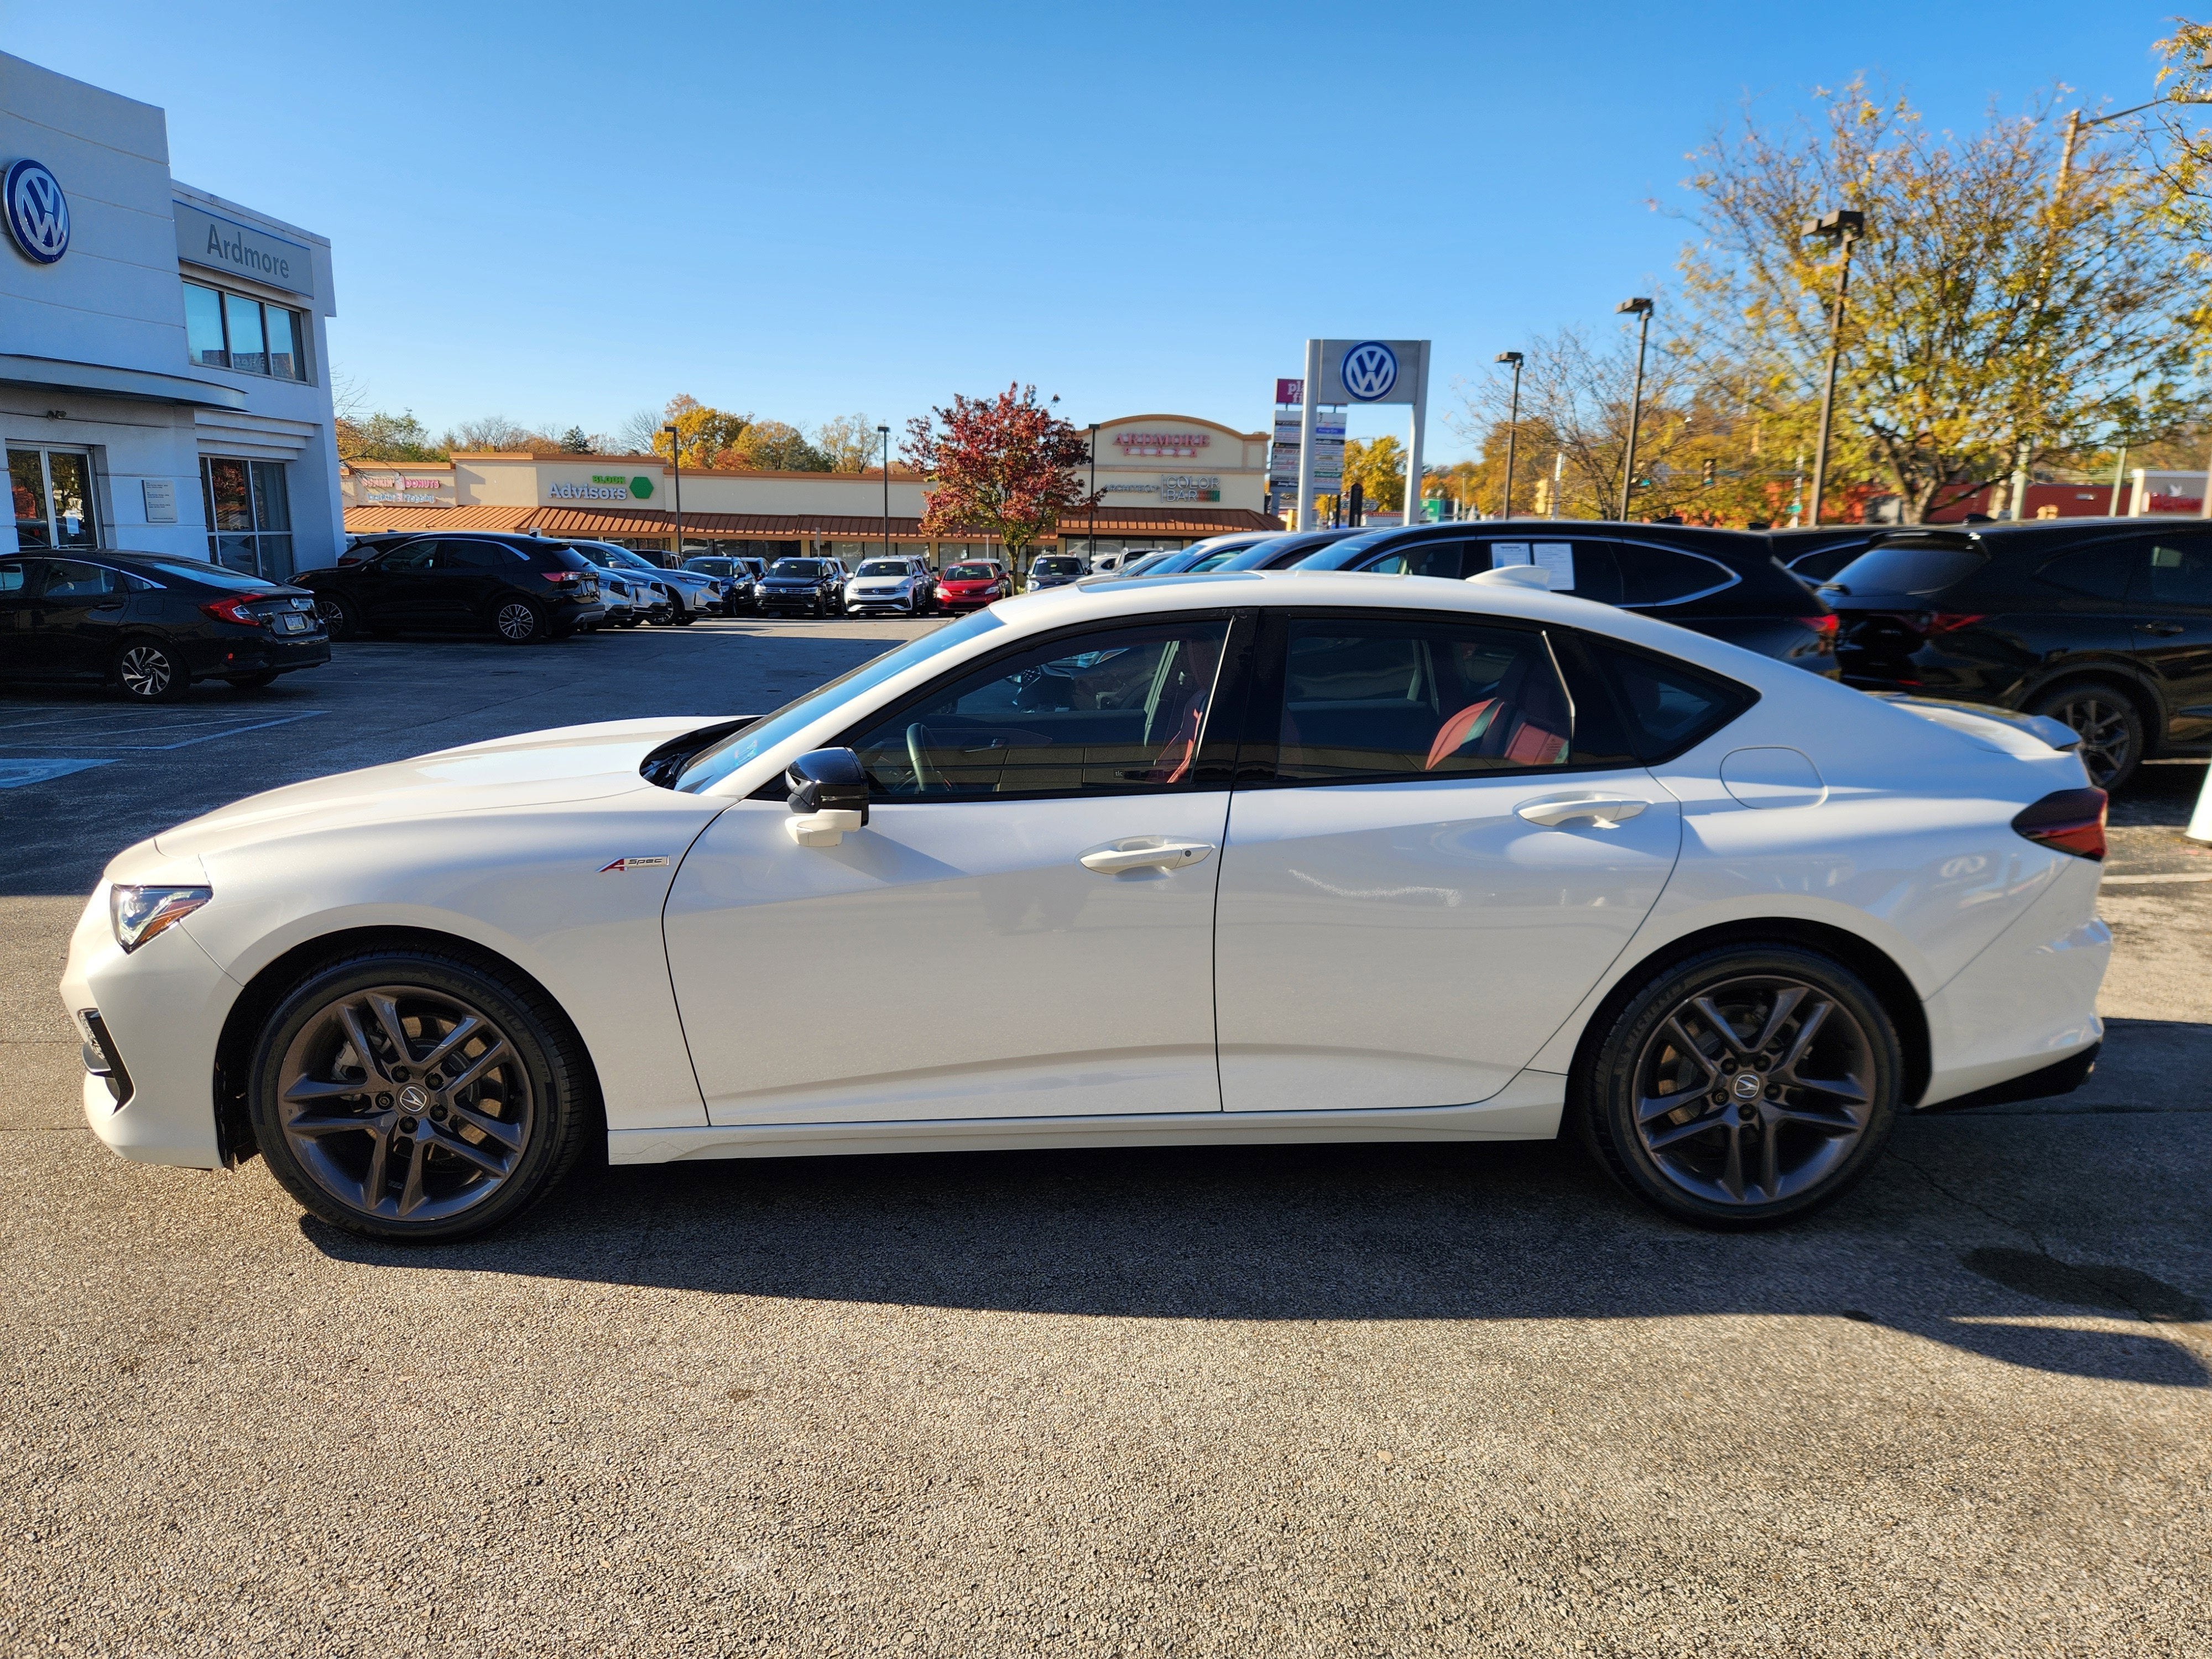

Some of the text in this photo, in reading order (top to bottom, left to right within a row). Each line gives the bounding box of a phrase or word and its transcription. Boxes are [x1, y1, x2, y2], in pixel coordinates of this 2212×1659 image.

[207, 223, 289, 279] Ardmore
[1113, 433, 1211, 448] ARDMORE
[1124, 446, 1198, 458] PLAZA
[404, 478, 441, 489] DONUTS
[592, 475, 625, 484] BLOCK
[1166, 475, 1220, 490] COLOR
[548, 482, 628, 500] Advisors
[1167, 489, 1197, 502] BAR
